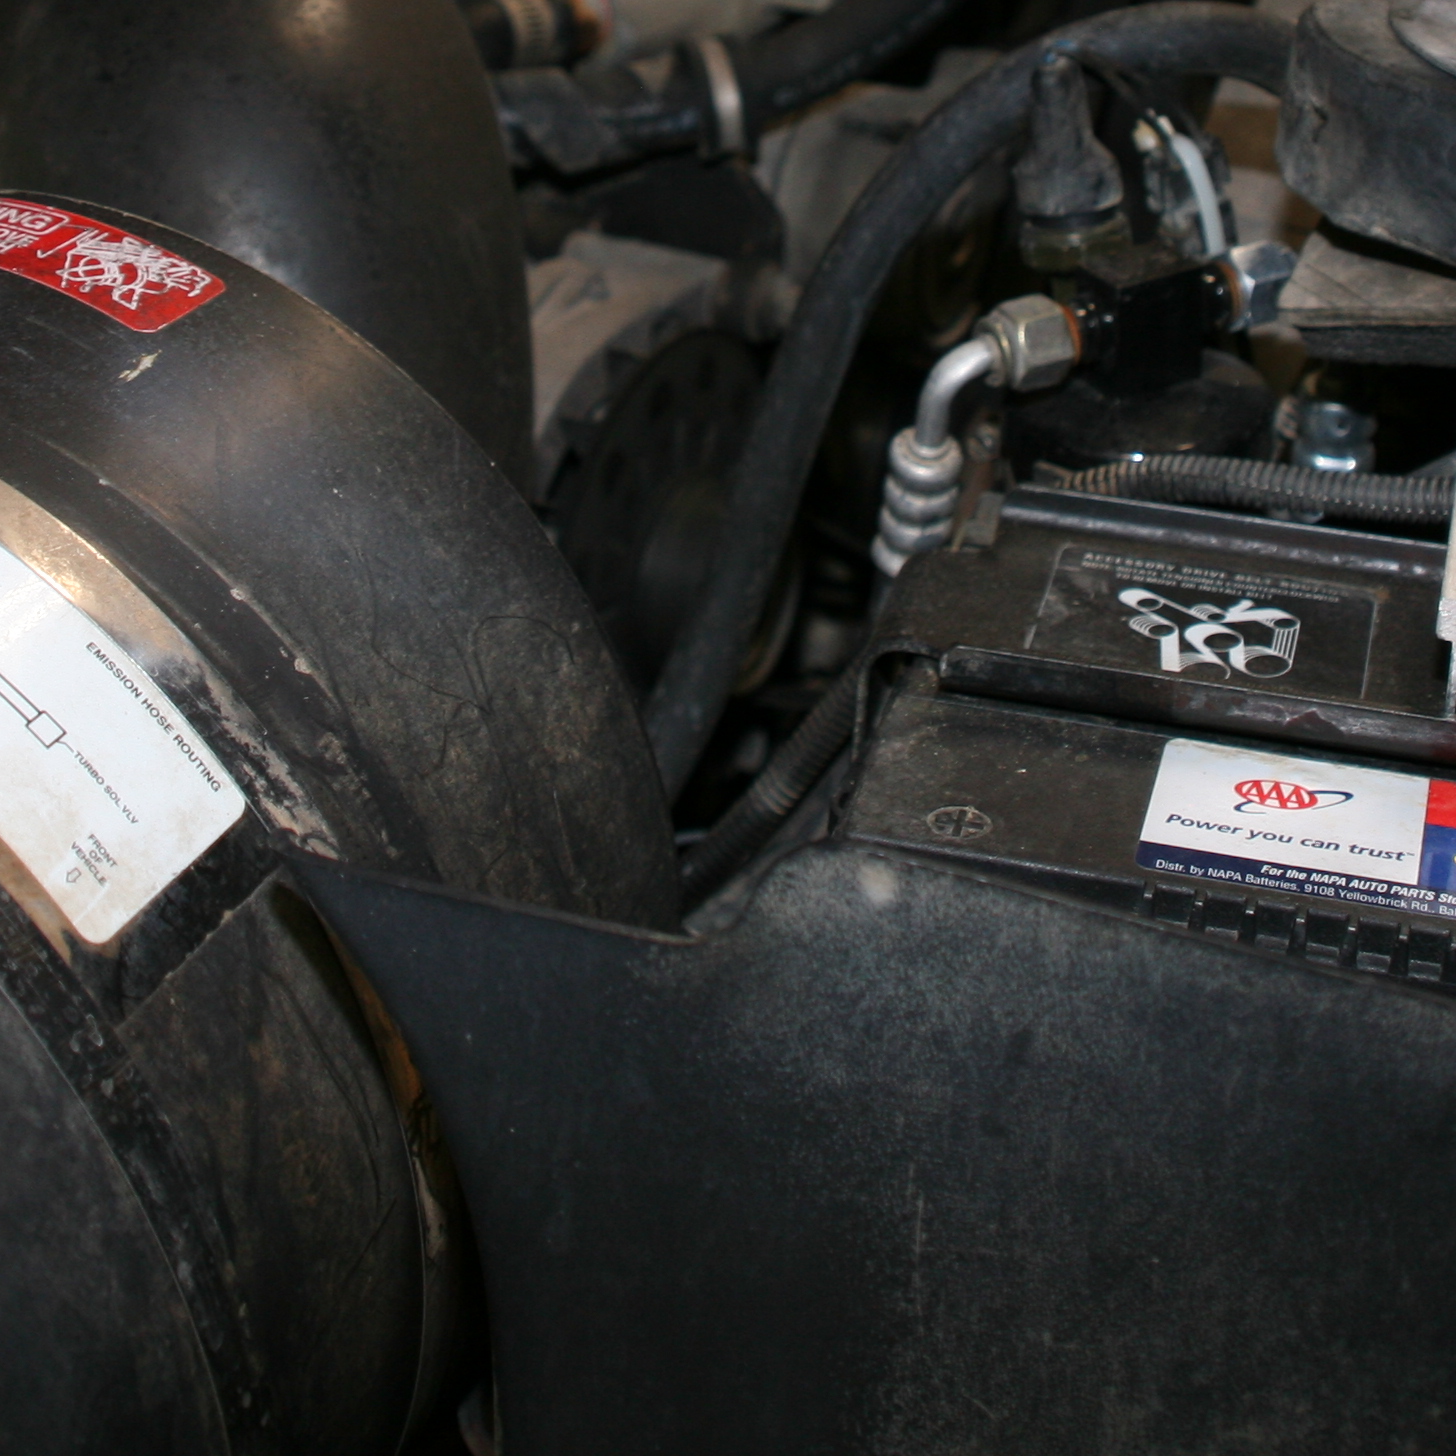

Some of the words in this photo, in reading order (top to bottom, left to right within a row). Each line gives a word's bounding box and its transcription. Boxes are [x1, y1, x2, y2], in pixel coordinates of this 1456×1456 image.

[85, 641, 143, 704] EMISSION
[140, 695, 175, 735] HOSE
[172, 733, 222, 793] ROUTING
[73, 751, 105, 785] TURBO
[103, 784, 122, 808] SOL
[121, 804, 139, 825] VLV
[1239, 779, 1312, 810] AAA
[86, 833, 118, 869] FRONT
[1165, 813, 1244, 835] Power
[1245, 829, 1294, 844] you
[1300, 837, 1341, 851] can
[70, 841, 108, 887] VEHICLE
[88, 849, 104, 865] OF
[1155, 858, 1186, 873] Distr.
[1189, 864, 1206, 877] by
[1207, 867, 1243, 882] NAPA
[1304, 884, 1335, 897] 9108
[1338, 889, 1408, 910] Yellowbrick
[1260, 864, 1285, 877] For
[1286, 869, 1308, 880] the
[1309, 872, 1348, 887] NAPA
[1349, 878, 1389, 894] AUTO
[1390, 885, 1436, 902] PARTS
